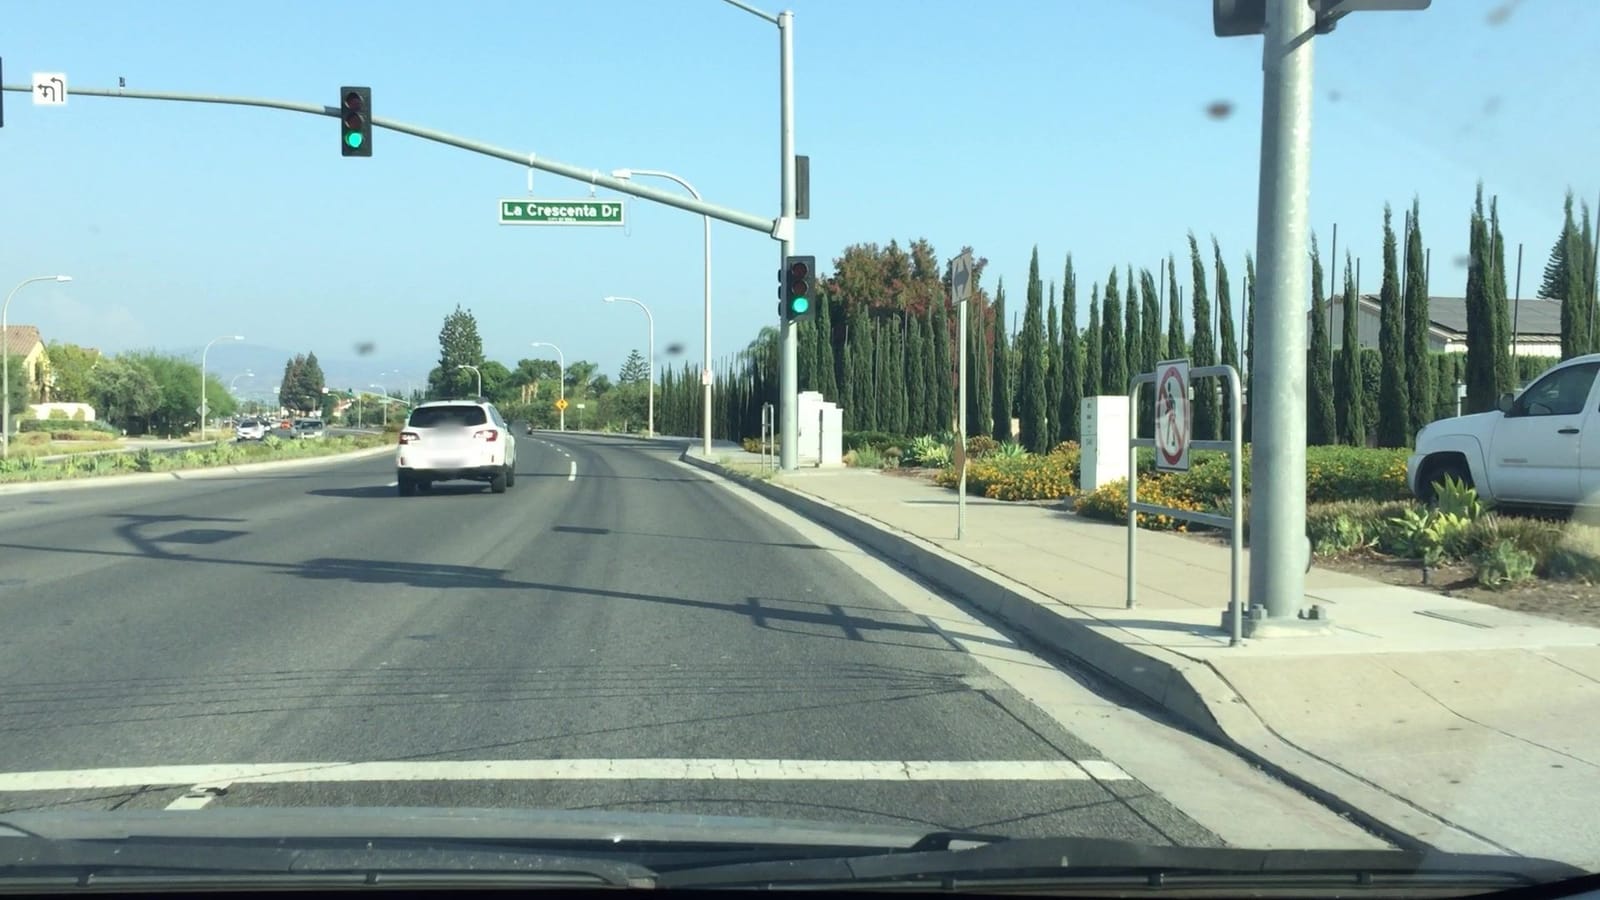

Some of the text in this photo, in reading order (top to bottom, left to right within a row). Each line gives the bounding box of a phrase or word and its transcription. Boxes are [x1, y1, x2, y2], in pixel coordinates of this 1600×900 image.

[503, 203, 619, 217] La Crescenta Dr
